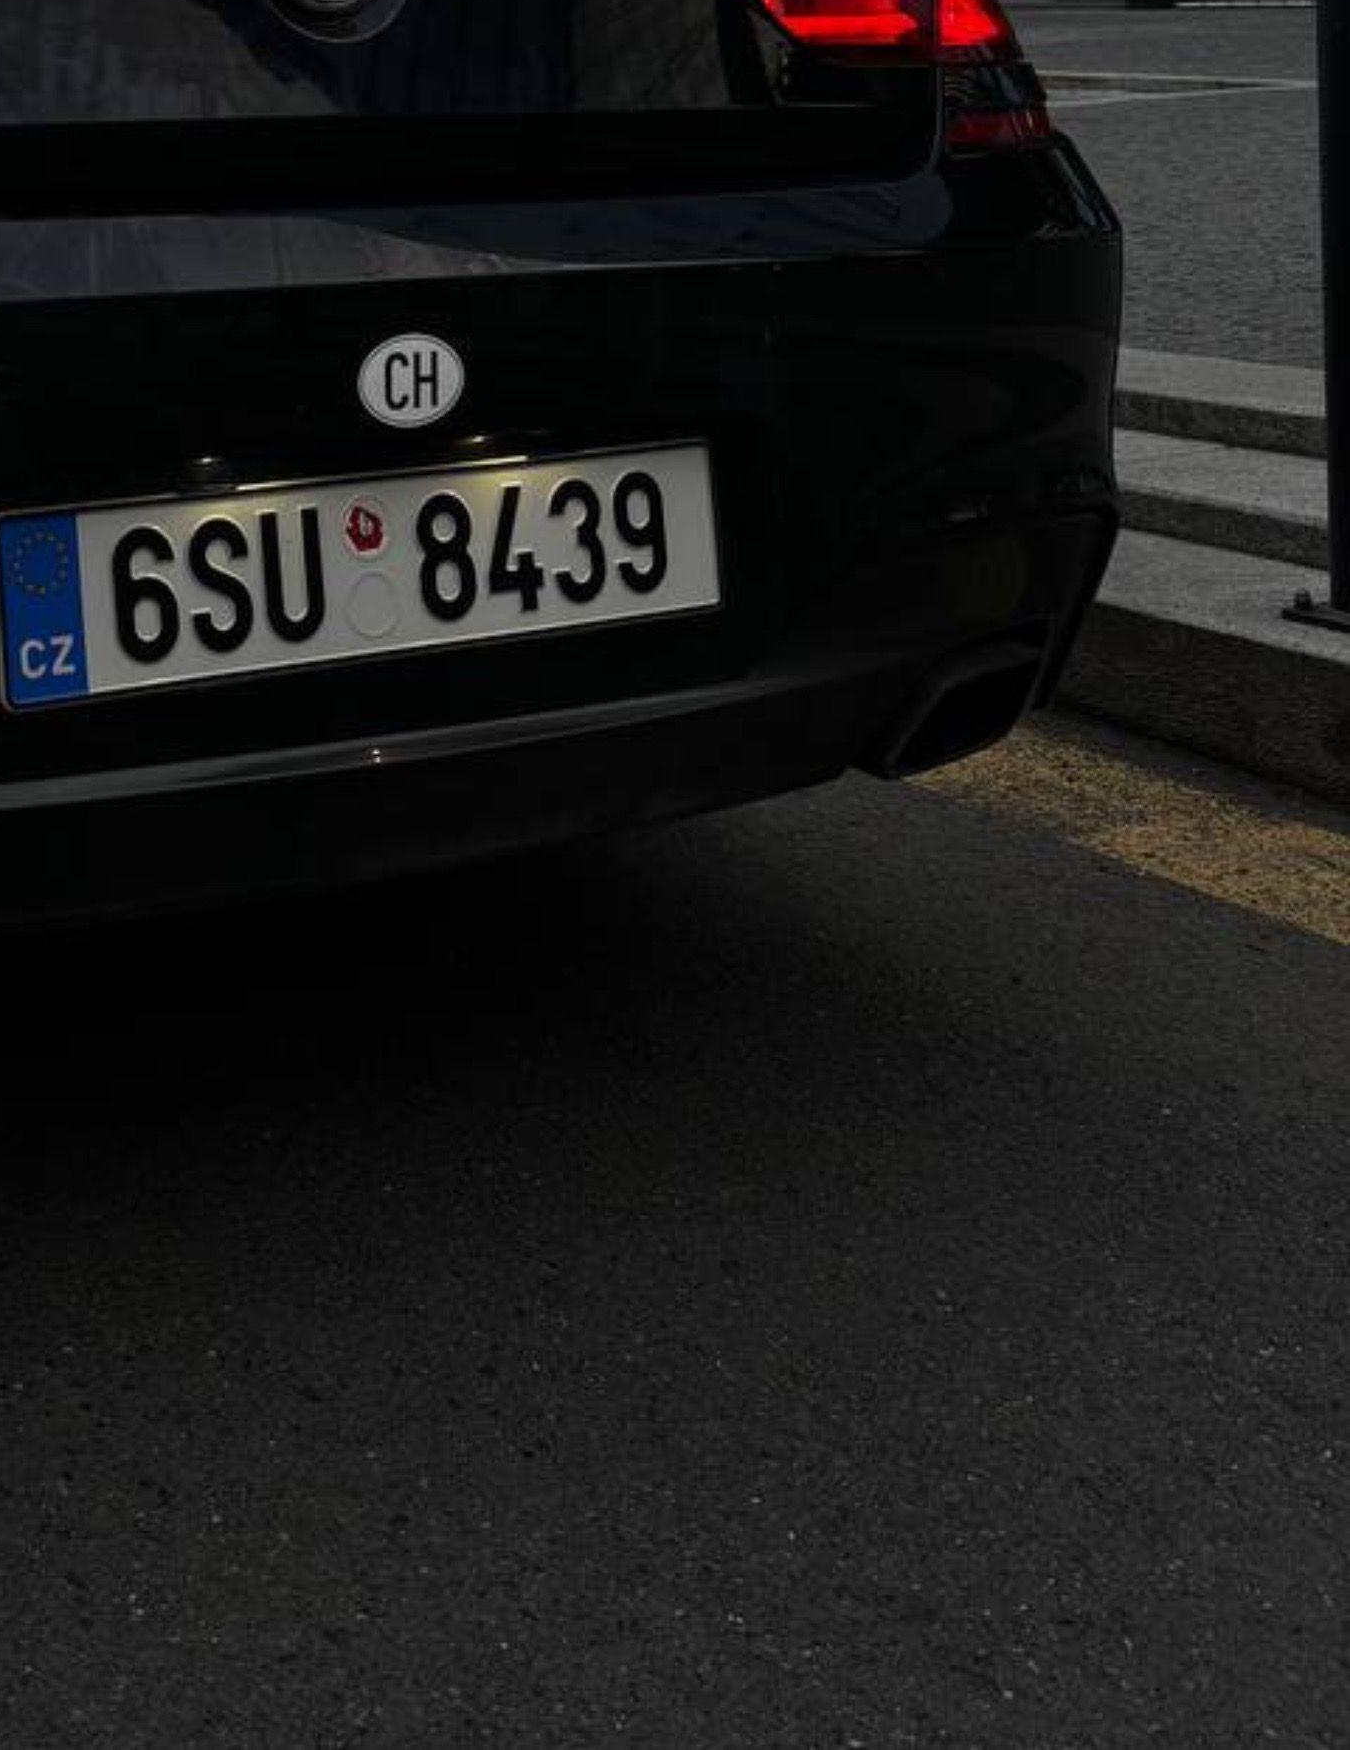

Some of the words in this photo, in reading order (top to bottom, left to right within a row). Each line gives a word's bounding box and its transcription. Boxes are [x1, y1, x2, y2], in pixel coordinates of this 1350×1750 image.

[385, 351, 438, 410] CH
[111, 504, 325, 663] 6SU
[416, 470, 667, 622] 8439
[20, 634, 76, 679] CZ
